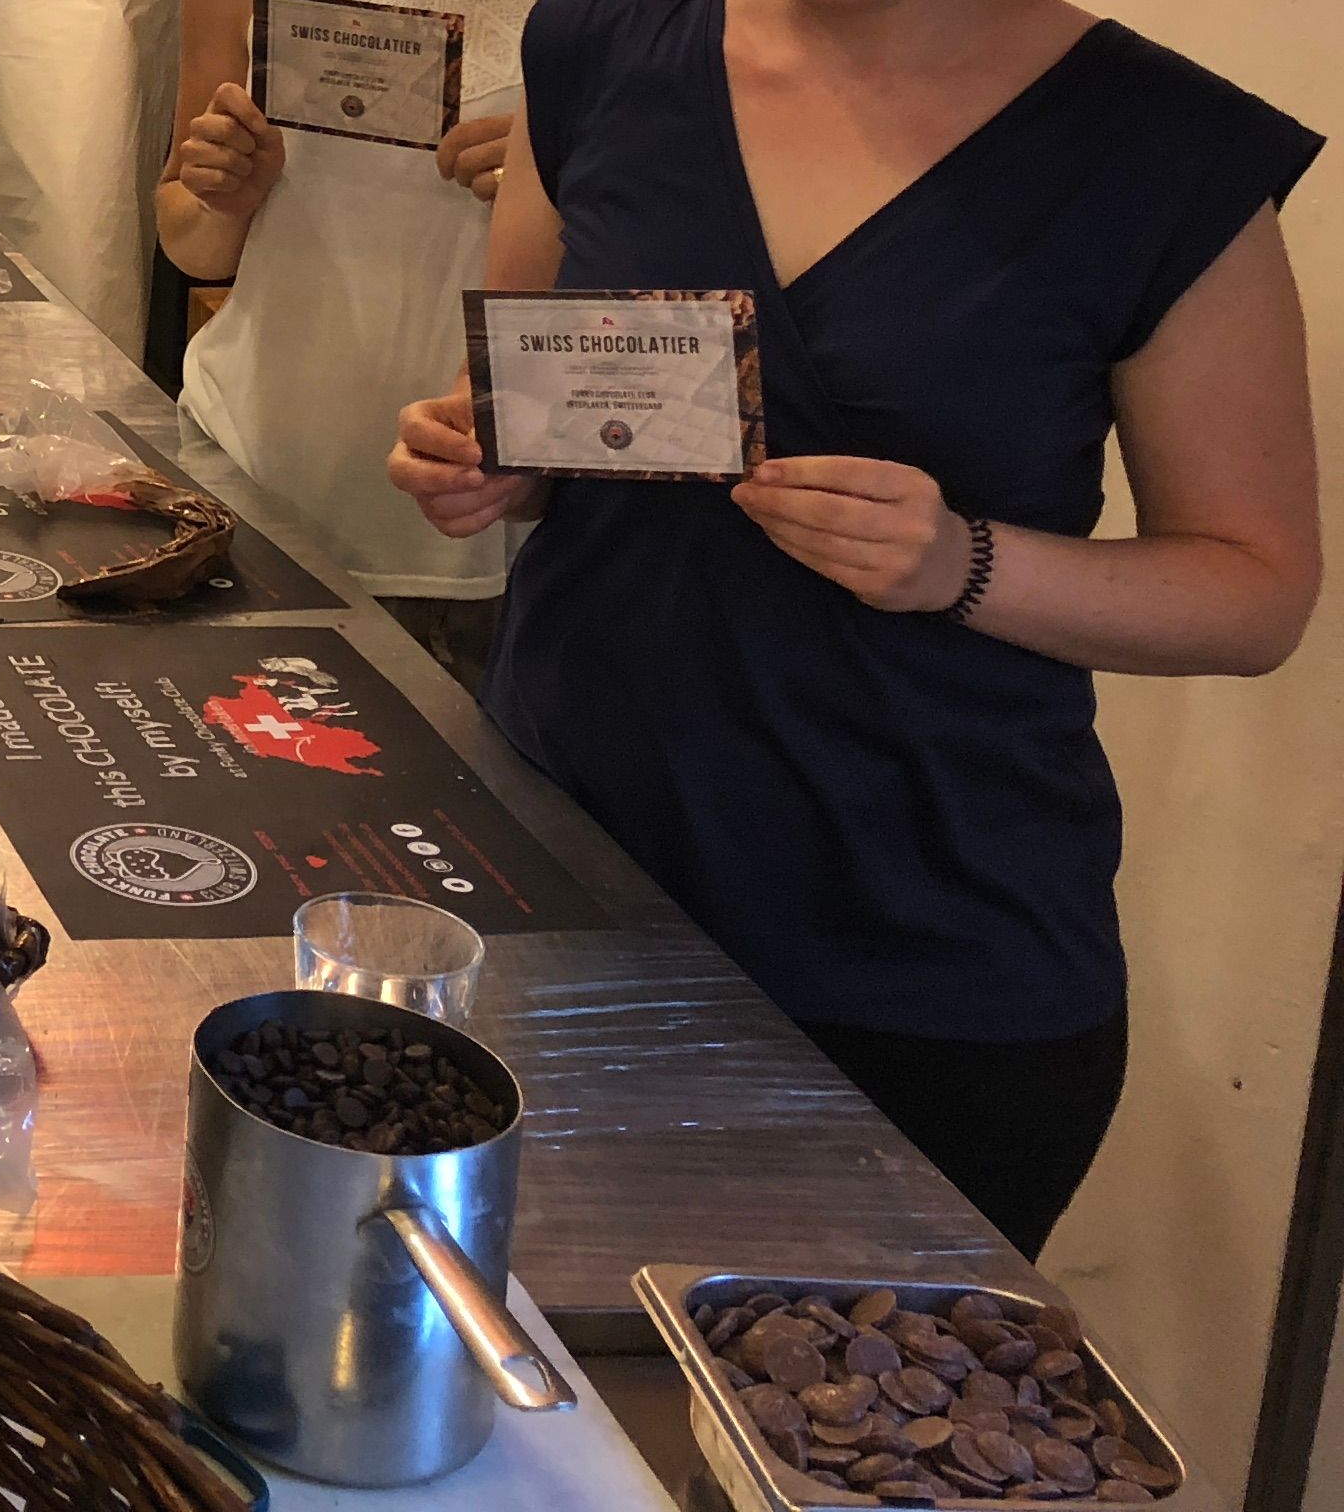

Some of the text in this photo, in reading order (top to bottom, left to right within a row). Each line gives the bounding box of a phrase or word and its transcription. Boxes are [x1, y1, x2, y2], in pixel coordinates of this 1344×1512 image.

[291, 24, 422, 56] SWISS CHOCOLATIER
[520, 334, 700, 355] SWISS CHOCOLATIER
[8, 655, 146, 808] this CHOCOLATE
[94, 681, 200, 778] by myself!
[102, 876, 172, 901] FUNKY
